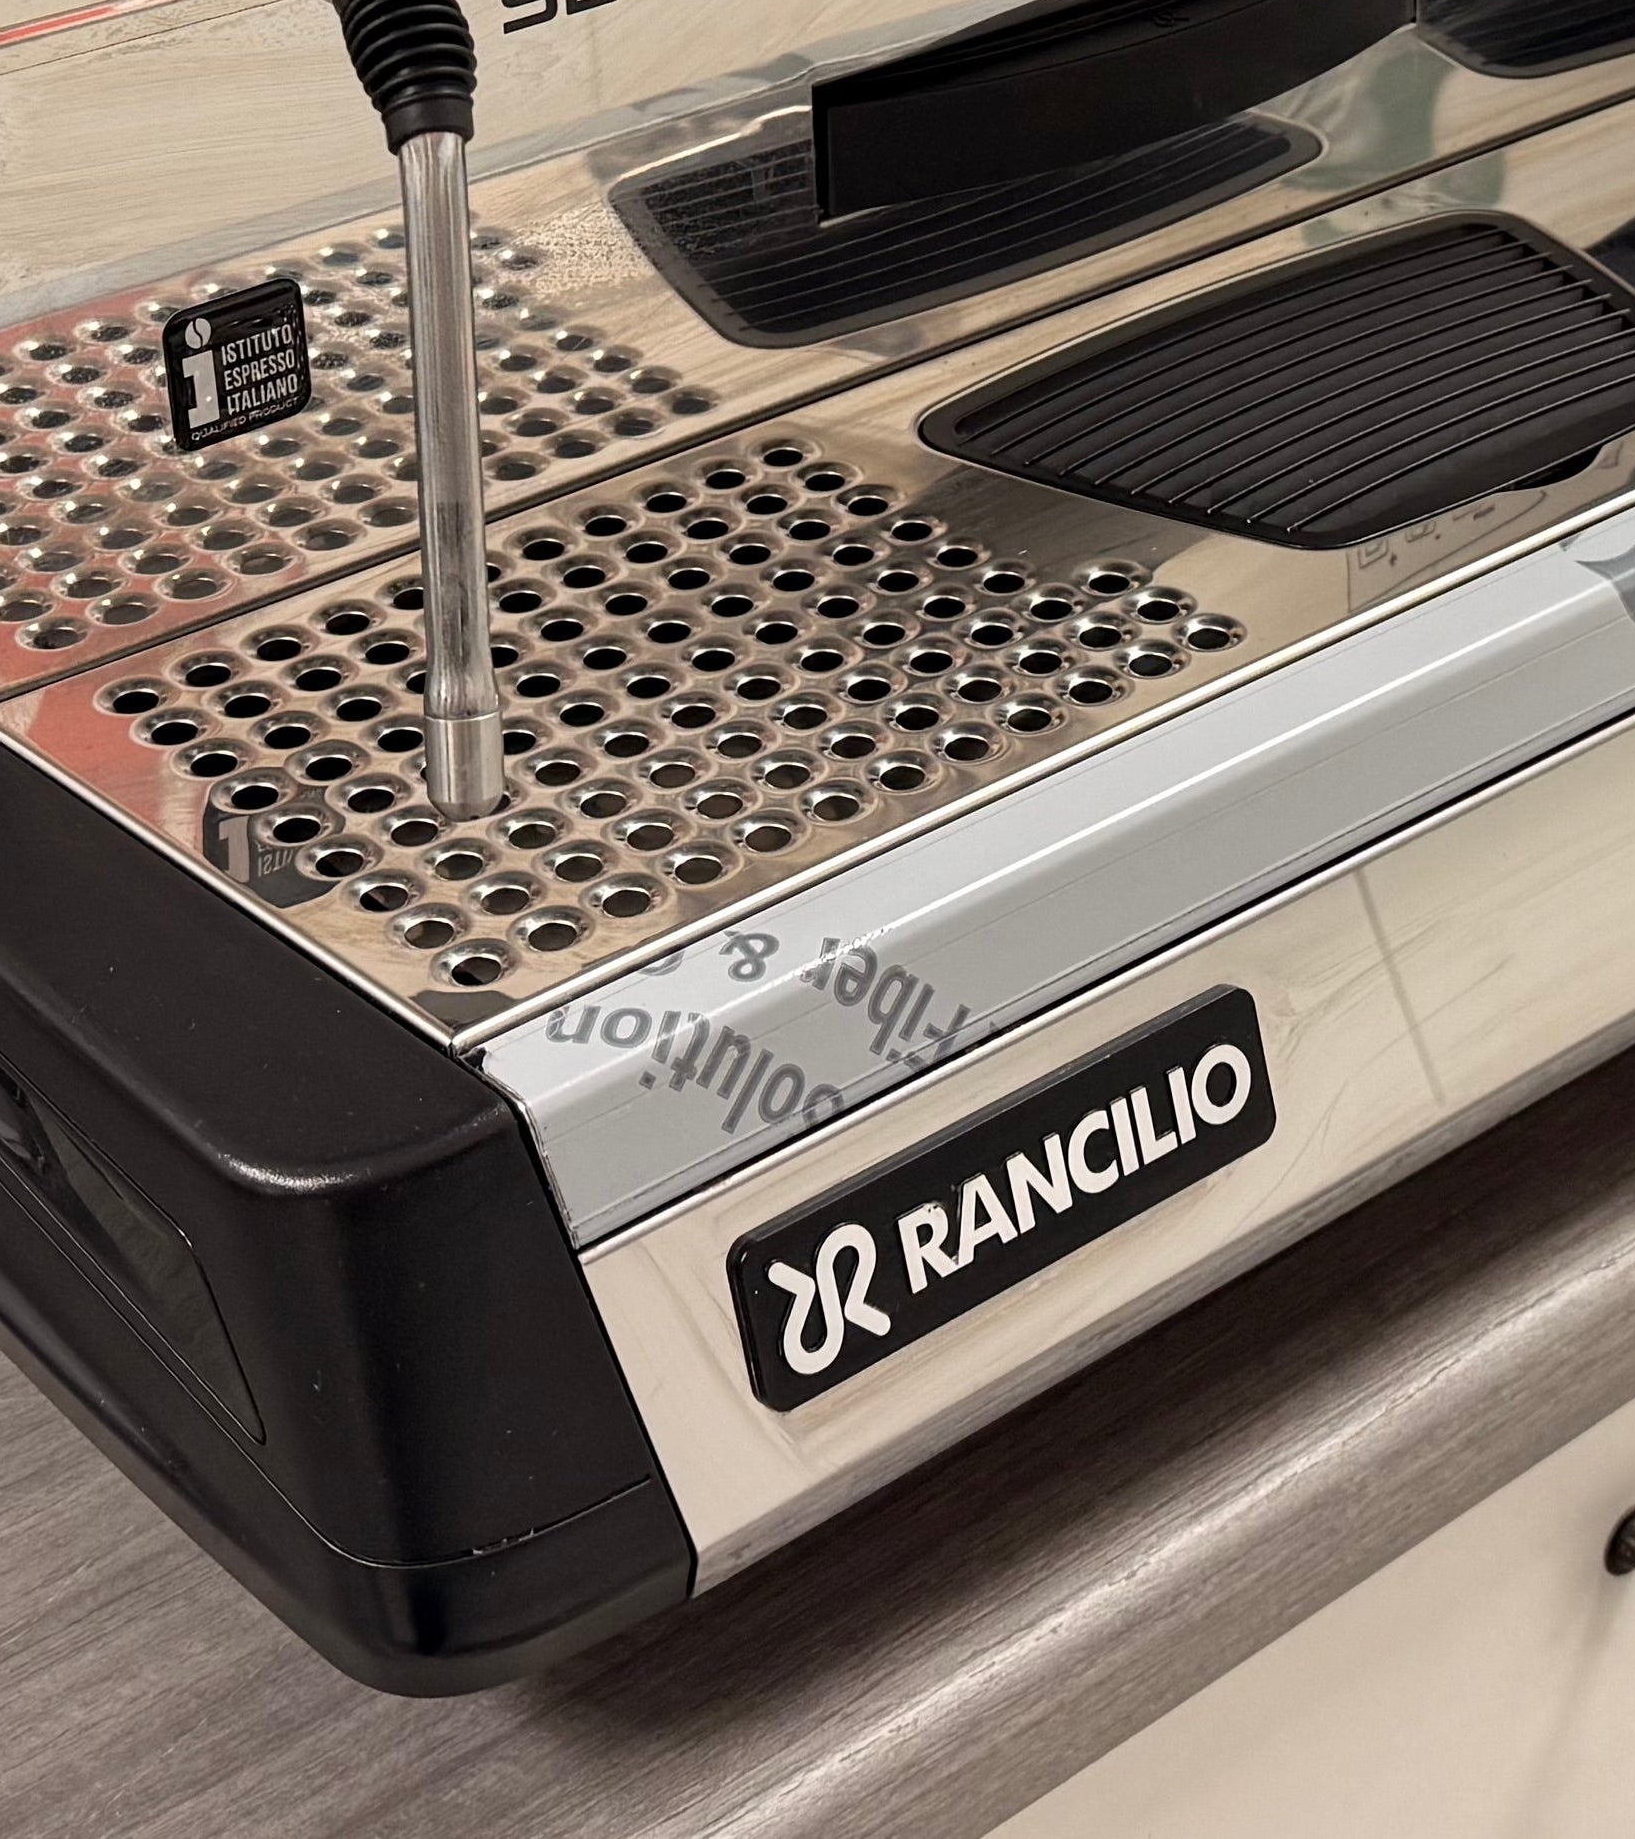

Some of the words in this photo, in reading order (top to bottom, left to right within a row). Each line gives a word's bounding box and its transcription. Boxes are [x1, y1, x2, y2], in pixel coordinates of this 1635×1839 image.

[221, 323, 294, 367] ISTITUTO
[223, 348, 296, 391] ESPRESSO
[226, 373, 299, 416] ITALIANO
[191, 415, 248, 442] QUALIFIED
[248, 396, 300, 423] PRODUCT
[718, 929, 781, 983] &
[799, 936, 973, 1071] Fiber
[896, 1042, 1253, 1295] RANCILIO
